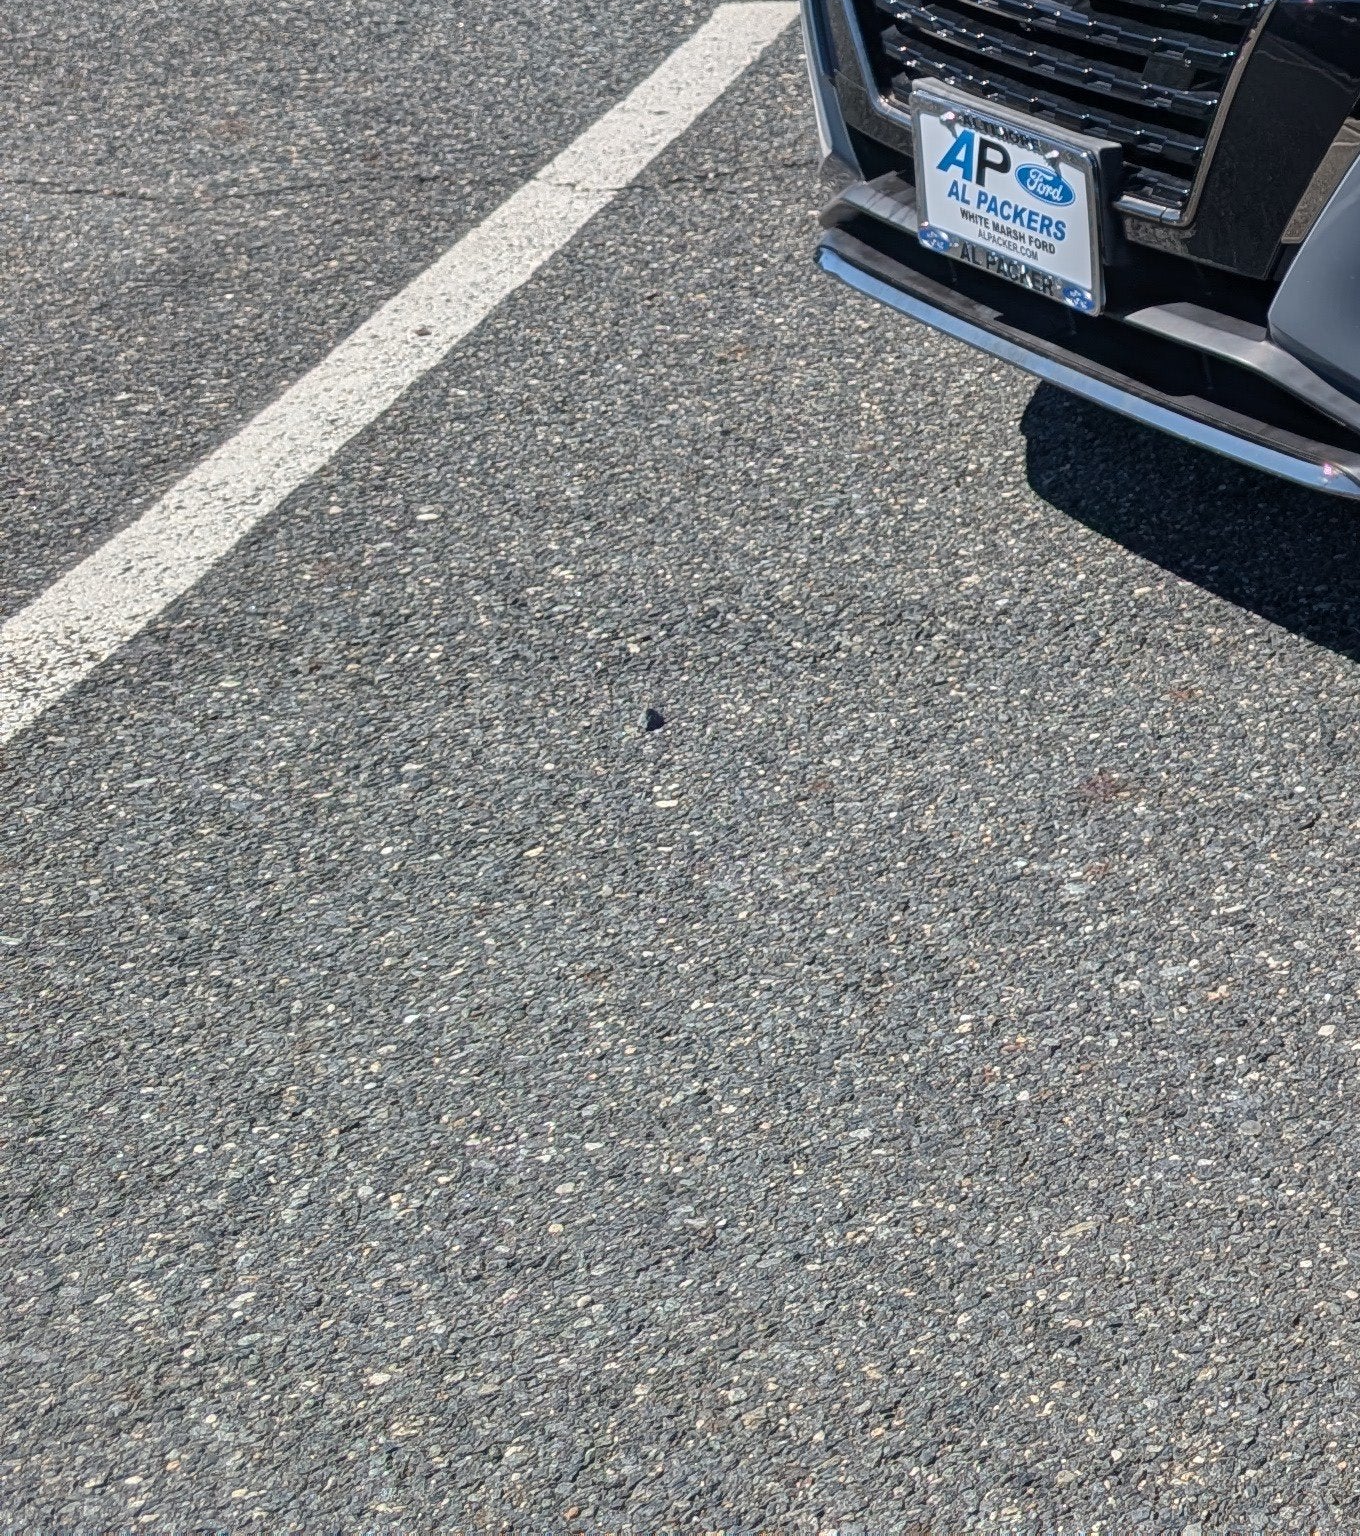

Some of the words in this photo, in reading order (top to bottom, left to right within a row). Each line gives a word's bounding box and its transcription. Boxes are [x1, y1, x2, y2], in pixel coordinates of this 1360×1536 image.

[936, 128, 1012, 188] AP
[947, 179, 970, 206] AL
[976, 189, 1068, 242] PACKERS
[1026, 168, 1064, 201] Ford
[960, 206, 990, 230] WHITE
[991, 220, 1026, 245] MARSH
[1028, 235, 1056, 255] FORD
[978, 228, 1039, 262] ALPACKER.COM
[960, 241, 981, 266] AL
[985, 250, 1055, 296] PACKER
